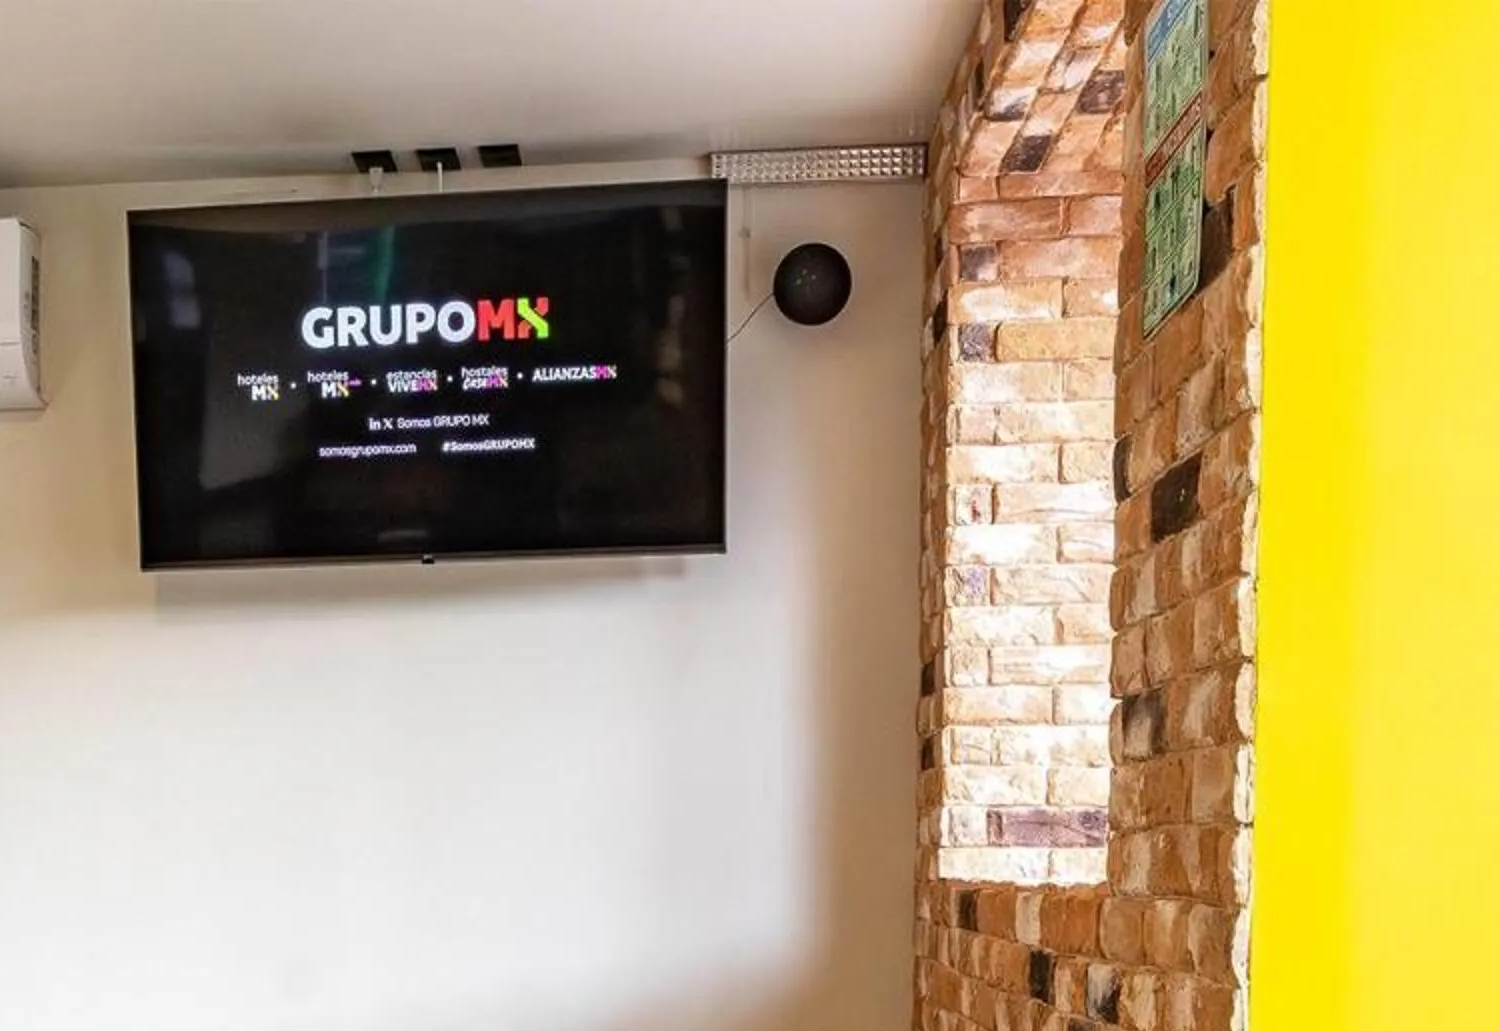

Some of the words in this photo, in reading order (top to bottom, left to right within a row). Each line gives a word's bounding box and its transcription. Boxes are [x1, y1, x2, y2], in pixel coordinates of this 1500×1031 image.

[301, 297, 550, 349] GRUPOMX
[237, 372, 279, 386] hoteles
[307, 370, 349, 383] hoteles
[461, 365, 509, 379] hostales
[531, 364, 617, 382] ALIANZASMX
[251, 384, 279, 401] MX
[321, 382, 349, 399] MX
[387, 377, 438, 392] VIVEMX
[397, 416, 431, 430] Somos
[433, 414, 470, 428] GRUPO
[472, 413, 489, 426] MX
[442, 437, 534, 452] #SomosGRUPOMX
